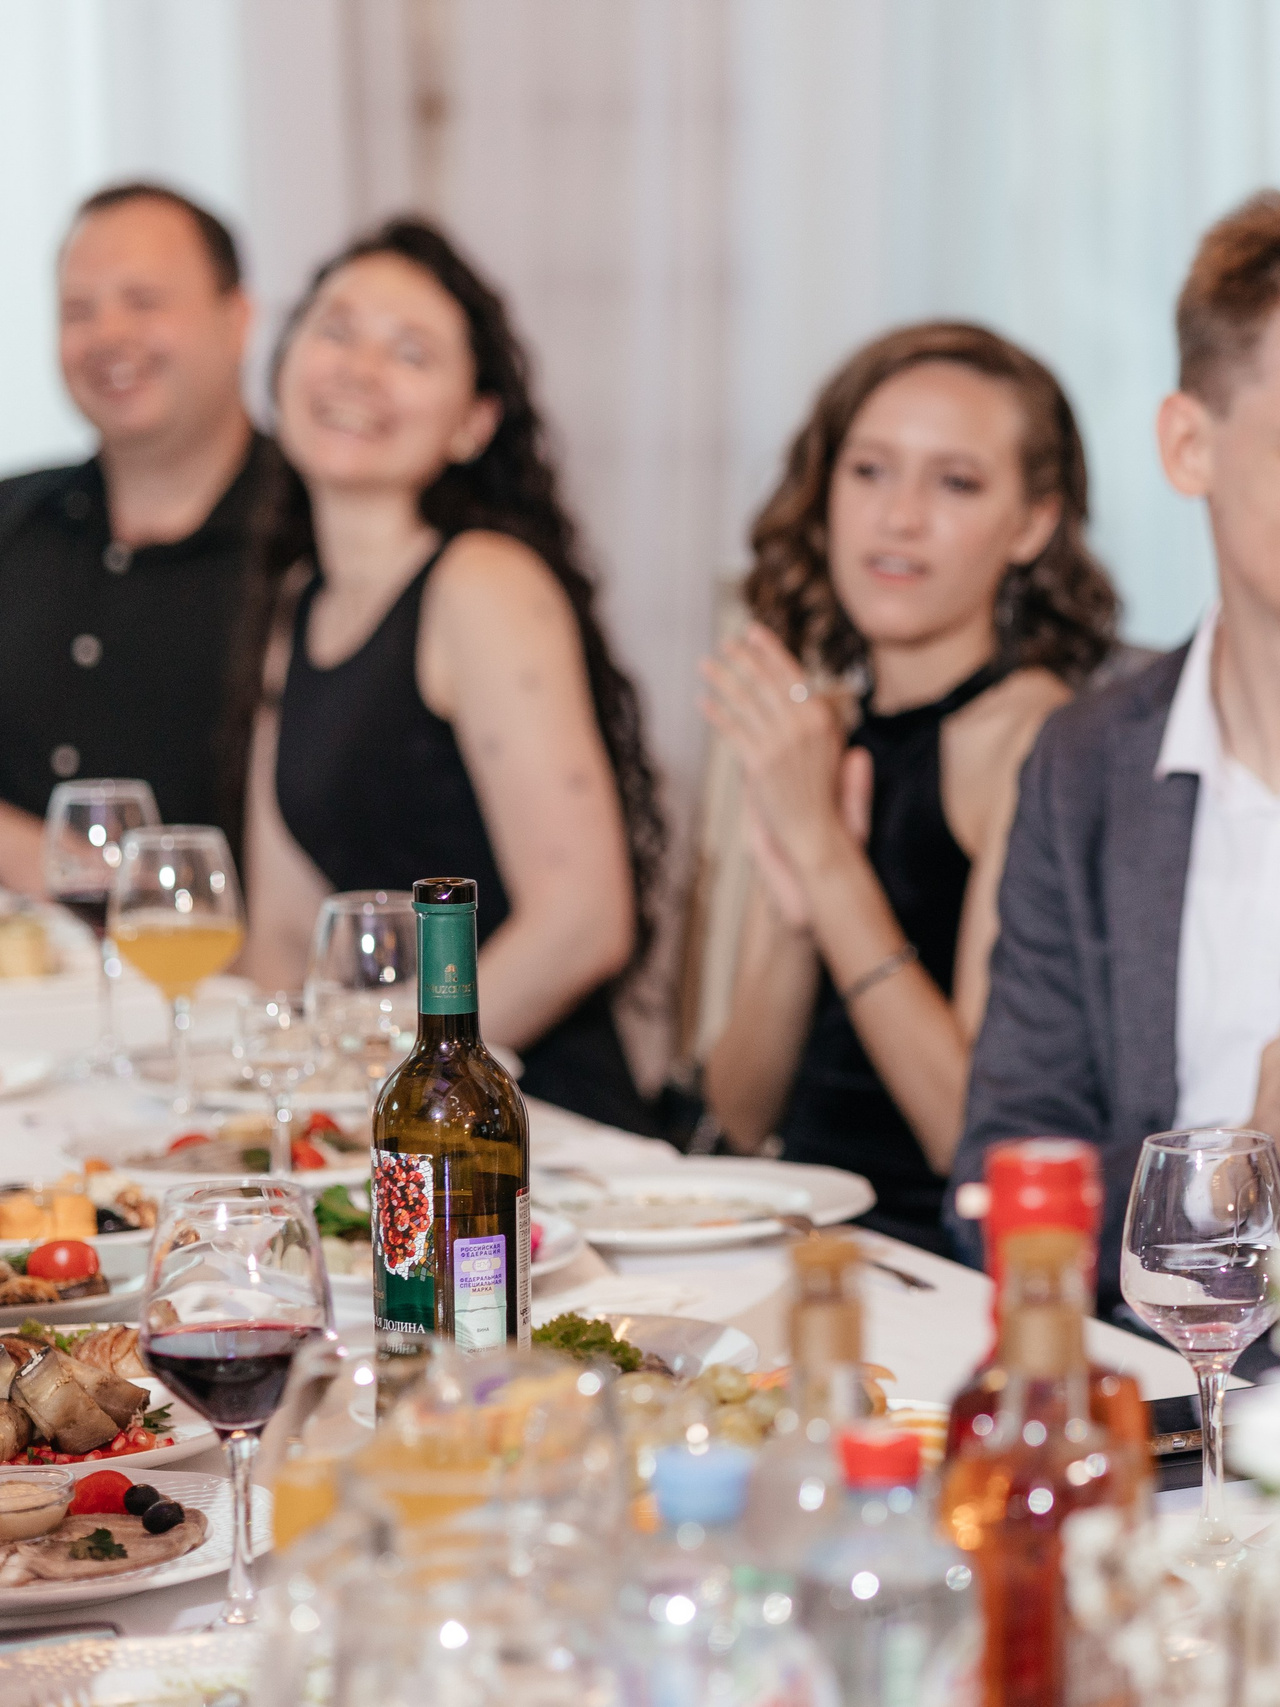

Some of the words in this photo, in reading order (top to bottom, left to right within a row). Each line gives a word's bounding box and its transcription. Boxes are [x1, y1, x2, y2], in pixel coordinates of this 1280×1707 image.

[460, 1243, 501, 1252] РОССИЙСКАЯ
[460, 1249, 501, 1258] ФЕДЕРАЦИЯ
[459, 1274, 502, 1283] ФЕДЕРАЛЬНАЯ
[459, 1279, 502, 1288] СПЕЦИАЛЬНАЯ
[382, 1318, 426, 1334] ДОЛИНА
